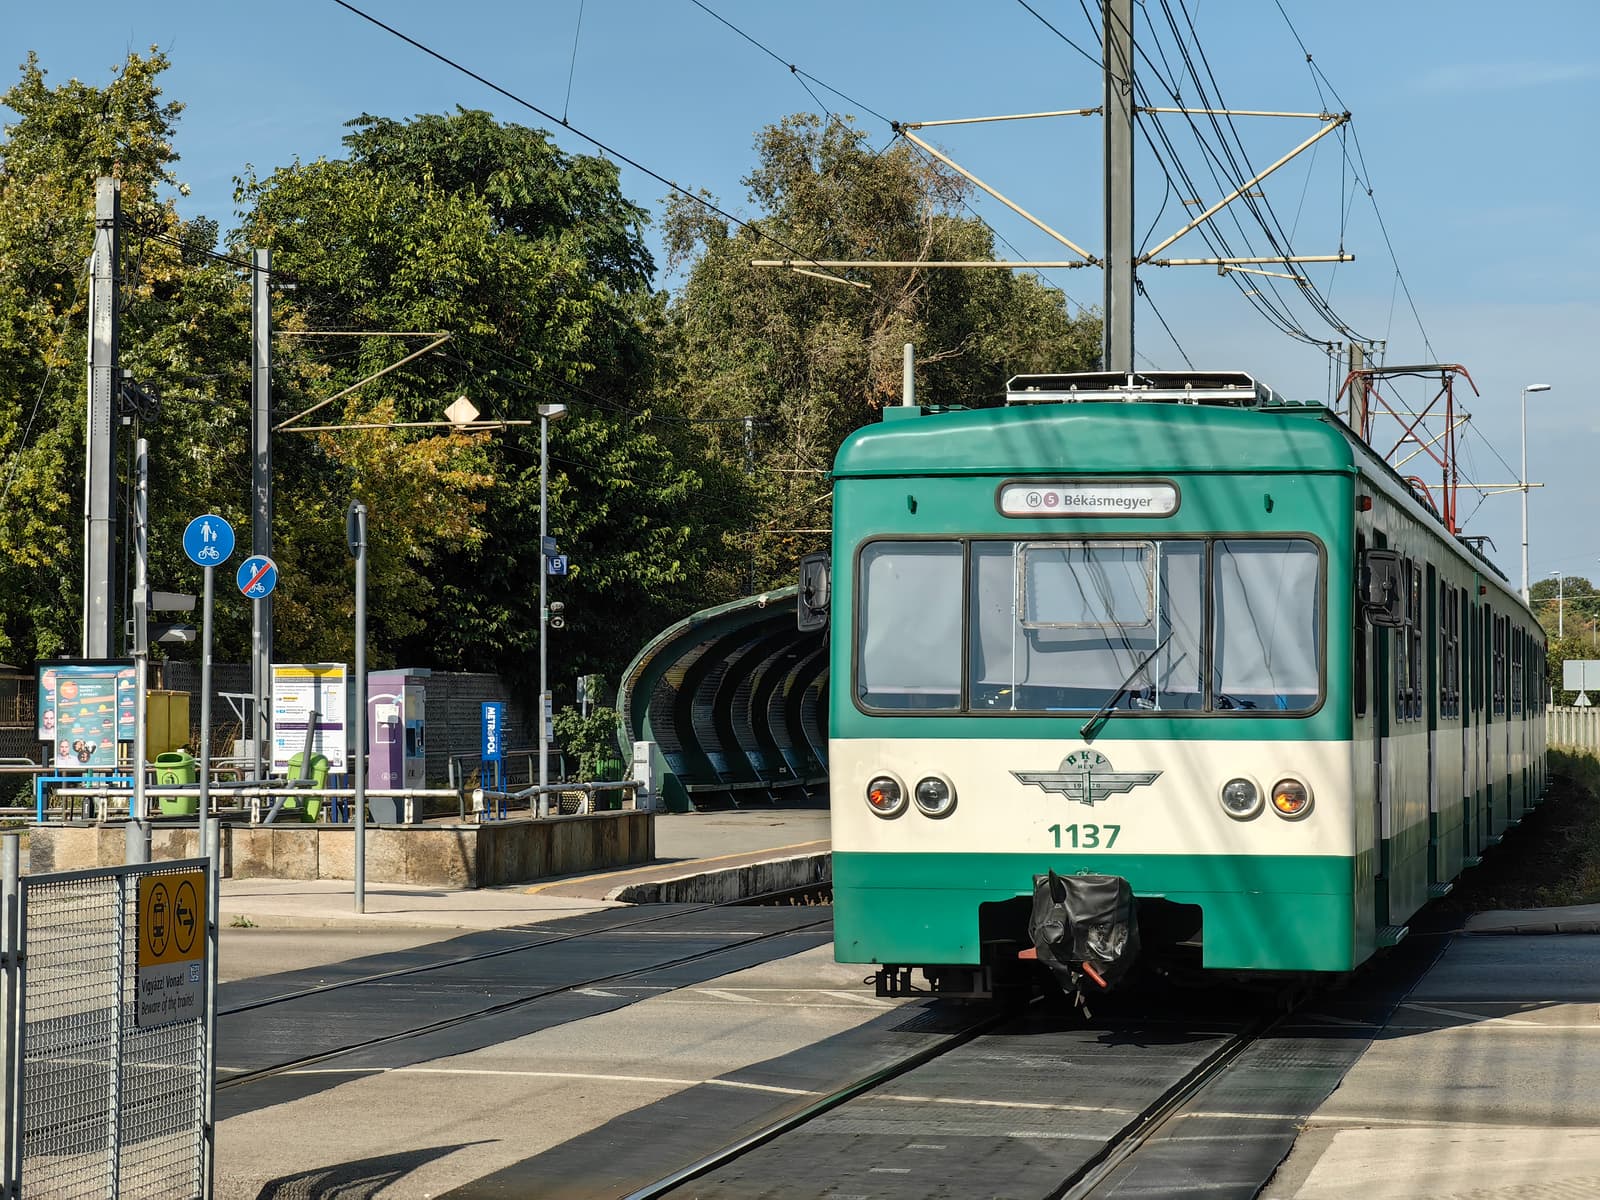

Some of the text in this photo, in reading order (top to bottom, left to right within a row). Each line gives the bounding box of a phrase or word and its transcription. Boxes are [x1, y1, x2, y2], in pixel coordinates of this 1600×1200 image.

[1064, 494, 1152, 510] Békásmegyer
[553, 558, 562, 569] B
[1048, 823, 1121, 849] 1137
[165, 973, 185, 988] Vonat!
[141, 1001, 161, 1016] Beware
[161, 996, 169, 1015] of
[168, 995, 177, 1010] the
